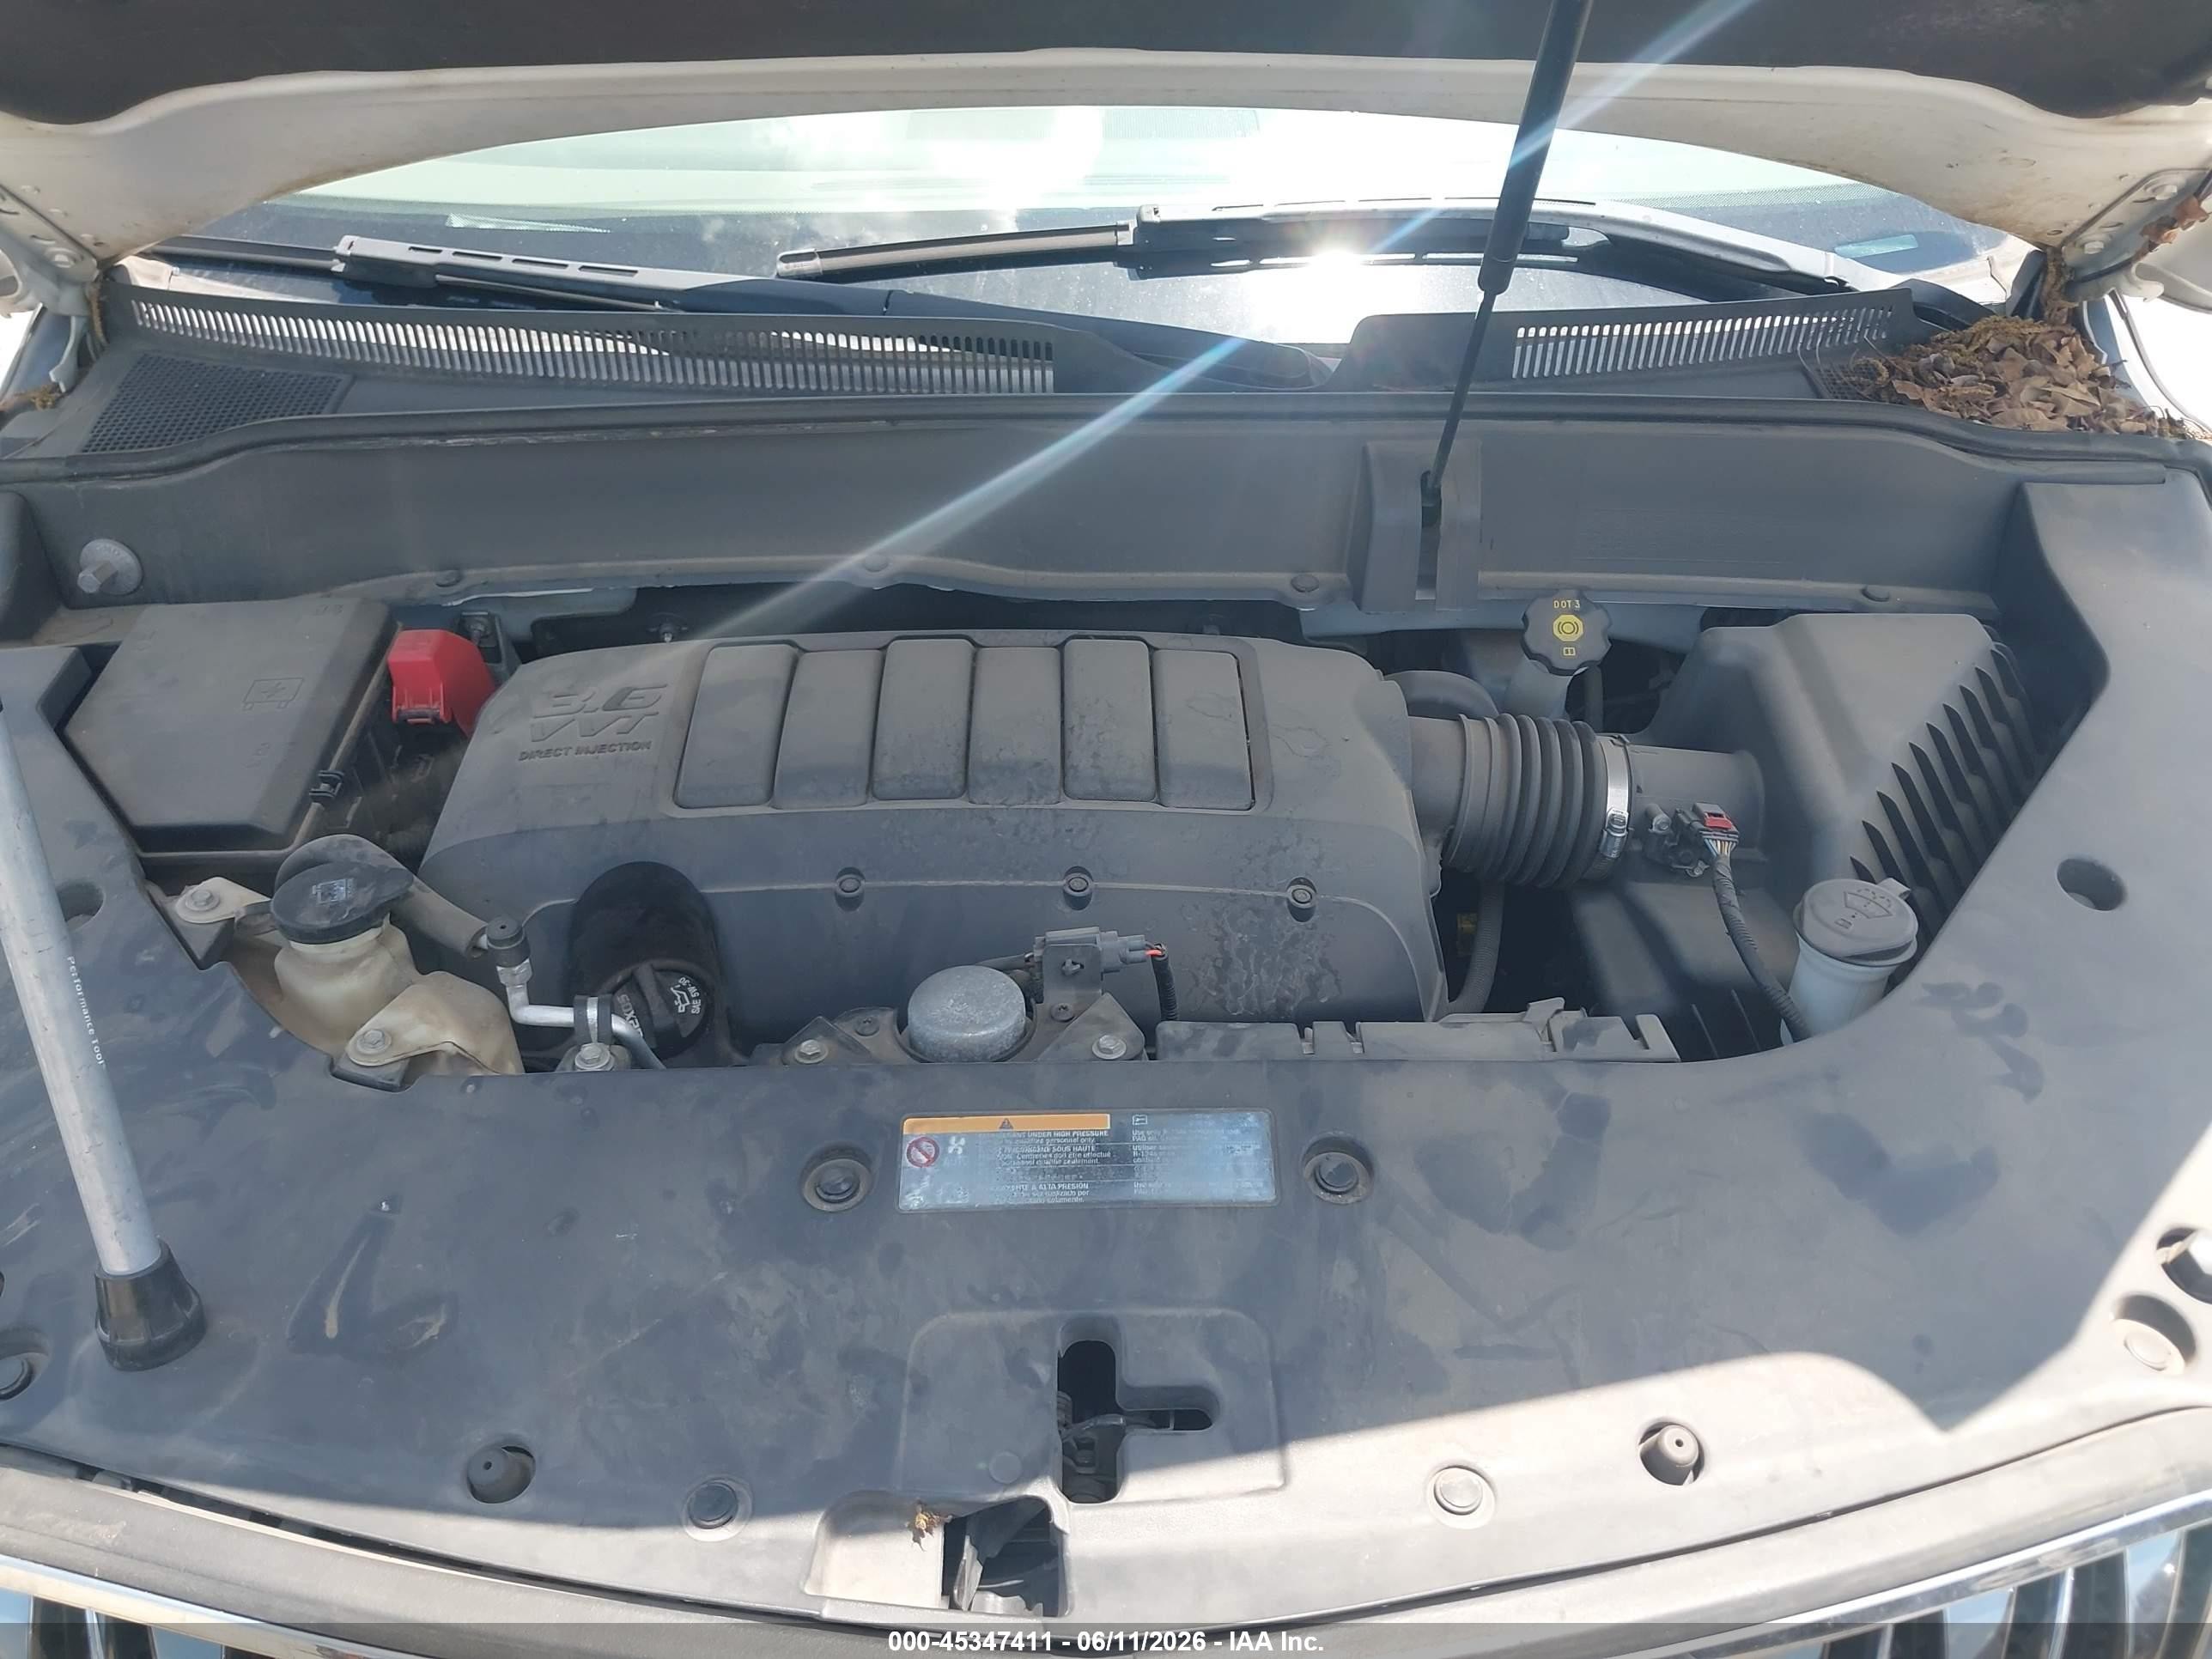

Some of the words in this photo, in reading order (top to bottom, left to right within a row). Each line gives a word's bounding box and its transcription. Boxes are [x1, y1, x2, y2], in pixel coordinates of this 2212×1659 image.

[1553, 599, 1571, 609] DOT
[1574, 599, 1581, 609] 3
[518, 745, 573, 762] DIRECT
[574, 740, 653, 757] INJECTION
[66, 955, 96, 1036] Performance
[690, 999, 701, 1015] SAE
